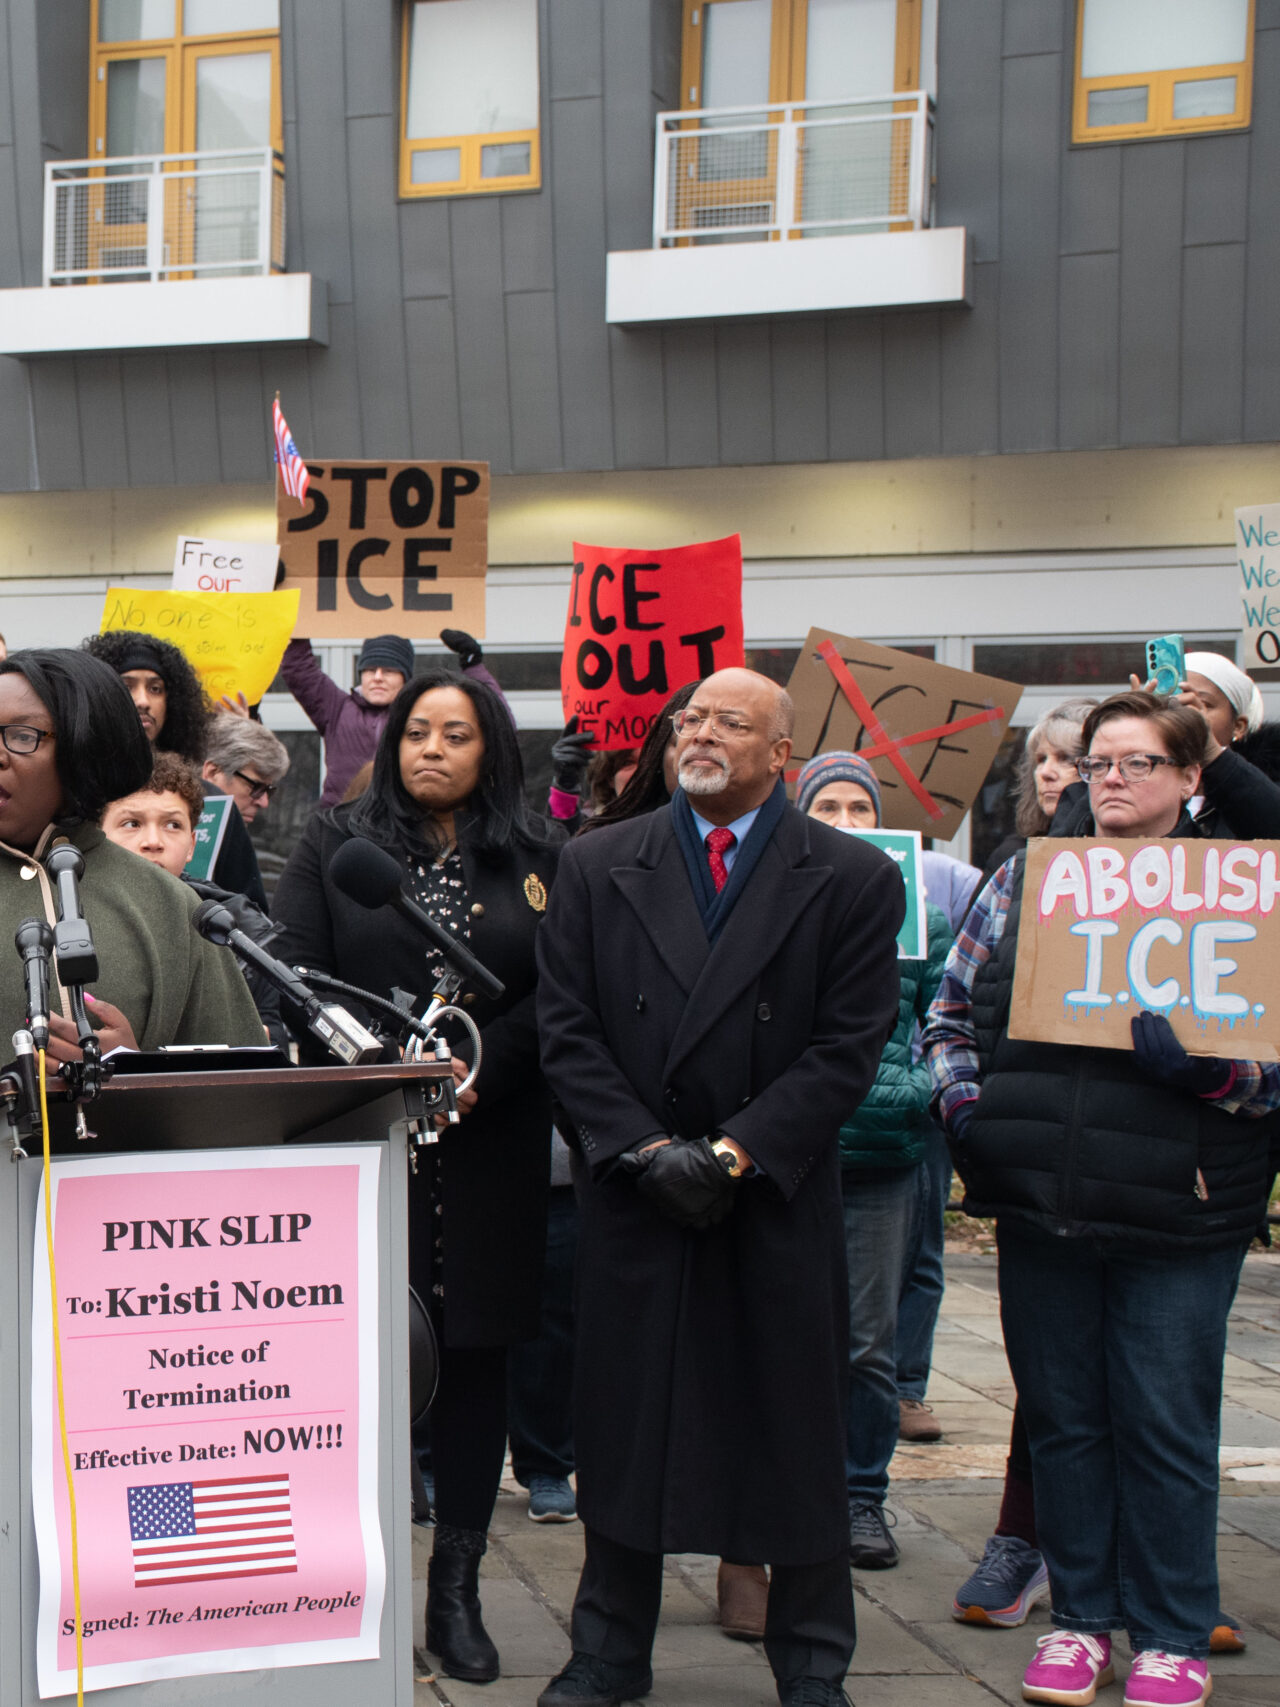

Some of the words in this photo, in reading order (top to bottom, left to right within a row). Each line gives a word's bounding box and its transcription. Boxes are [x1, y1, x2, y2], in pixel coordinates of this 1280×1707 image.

[288, 466, 480, 532] STOP
[1239, 515, 1280, 548] We
[182, 541, 243, 570] Free
[317, 538, 452, 611] ICE
[1240, 555, 1280, 590] We
[107, 600, 145, 629] No
[157, 608, 213, 630] one
[236, 604, 256, 629] is
[569, 562, 665, 635] ICE
[575, 700, 609, 715] our
[1064, 917, 1265, 1020] I.C.E.
[103, 1217, 211, 1252] PINK
[220, 1212, 312, 1247] SLIP
[67, 1296, 102, 1315] To:
[105, 1280, 221, 1318] Kristi
[232, 1279, 344, 1311] Noem
[148, 1344, 234, 1369] Notice
[241, 1340, 271, 1364] of
[123, 1379, 291, 1410] Termination
[74, 1446, 173, 1470] Effective
[179, 1444, 237, 1462] Date:
[243, 1423, 343, 1455] NOW!!!
[62, 1612, 140, 1637] Sgned:
[146, 1608, 183, 1627] The
[188, 1600, 289, 1622] American
[293, 1591, 361, 1614] People
